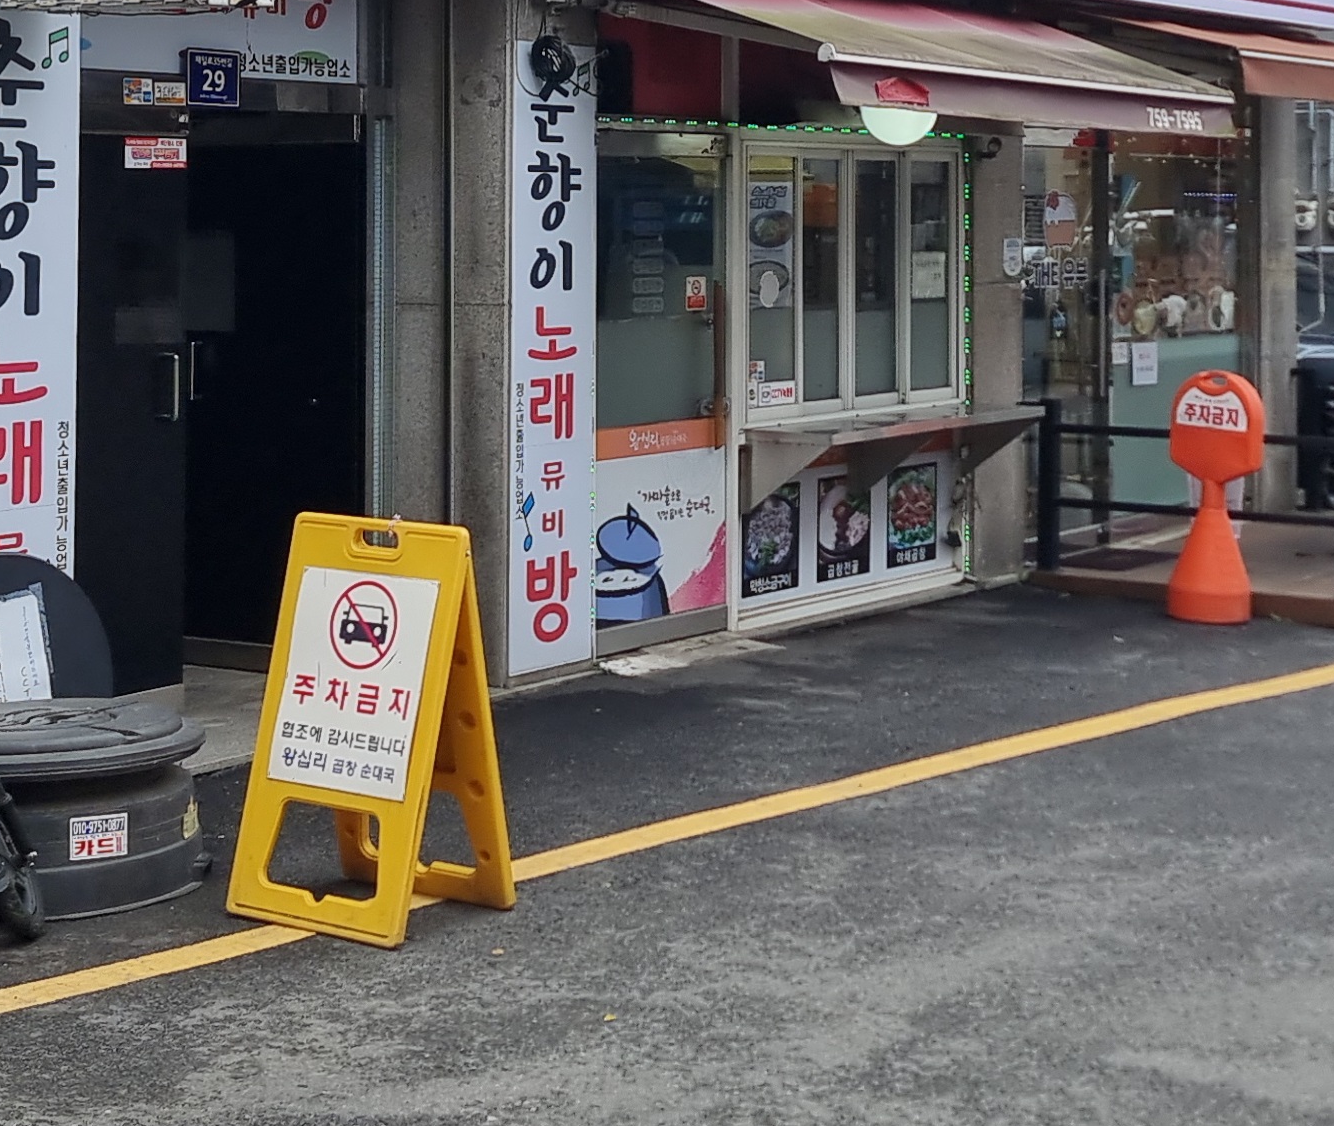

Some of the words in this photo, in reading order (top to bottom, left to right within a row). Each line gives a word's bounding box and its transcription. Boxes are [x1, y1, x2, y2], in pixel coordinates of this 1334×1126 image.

[202, 69, 225, 92] 29
[1146, 106, 1202, 131] 759-7595
[1033, 261, 1059, 289] THE
[1063, 257, 1088, 289] 유부
[1184, 403, 1239, 428] 주차금지
[896, 547, 926, 564] 야채곱창
[827, 559, 860, 579] 곱창전골
[21, 666, 33, 700] CCT
[292, 673, 411, 721] 주차금지
[282, 721, 322, 743] 협조에
[328, 727, 406, 757] 감사드립니다
[282, 746, 328, 771] 왕십리
[332, 758, 357, 777] 곱창
[360, 763, 395, 784] 순대국
[75, 838, 114, 856] 카드
